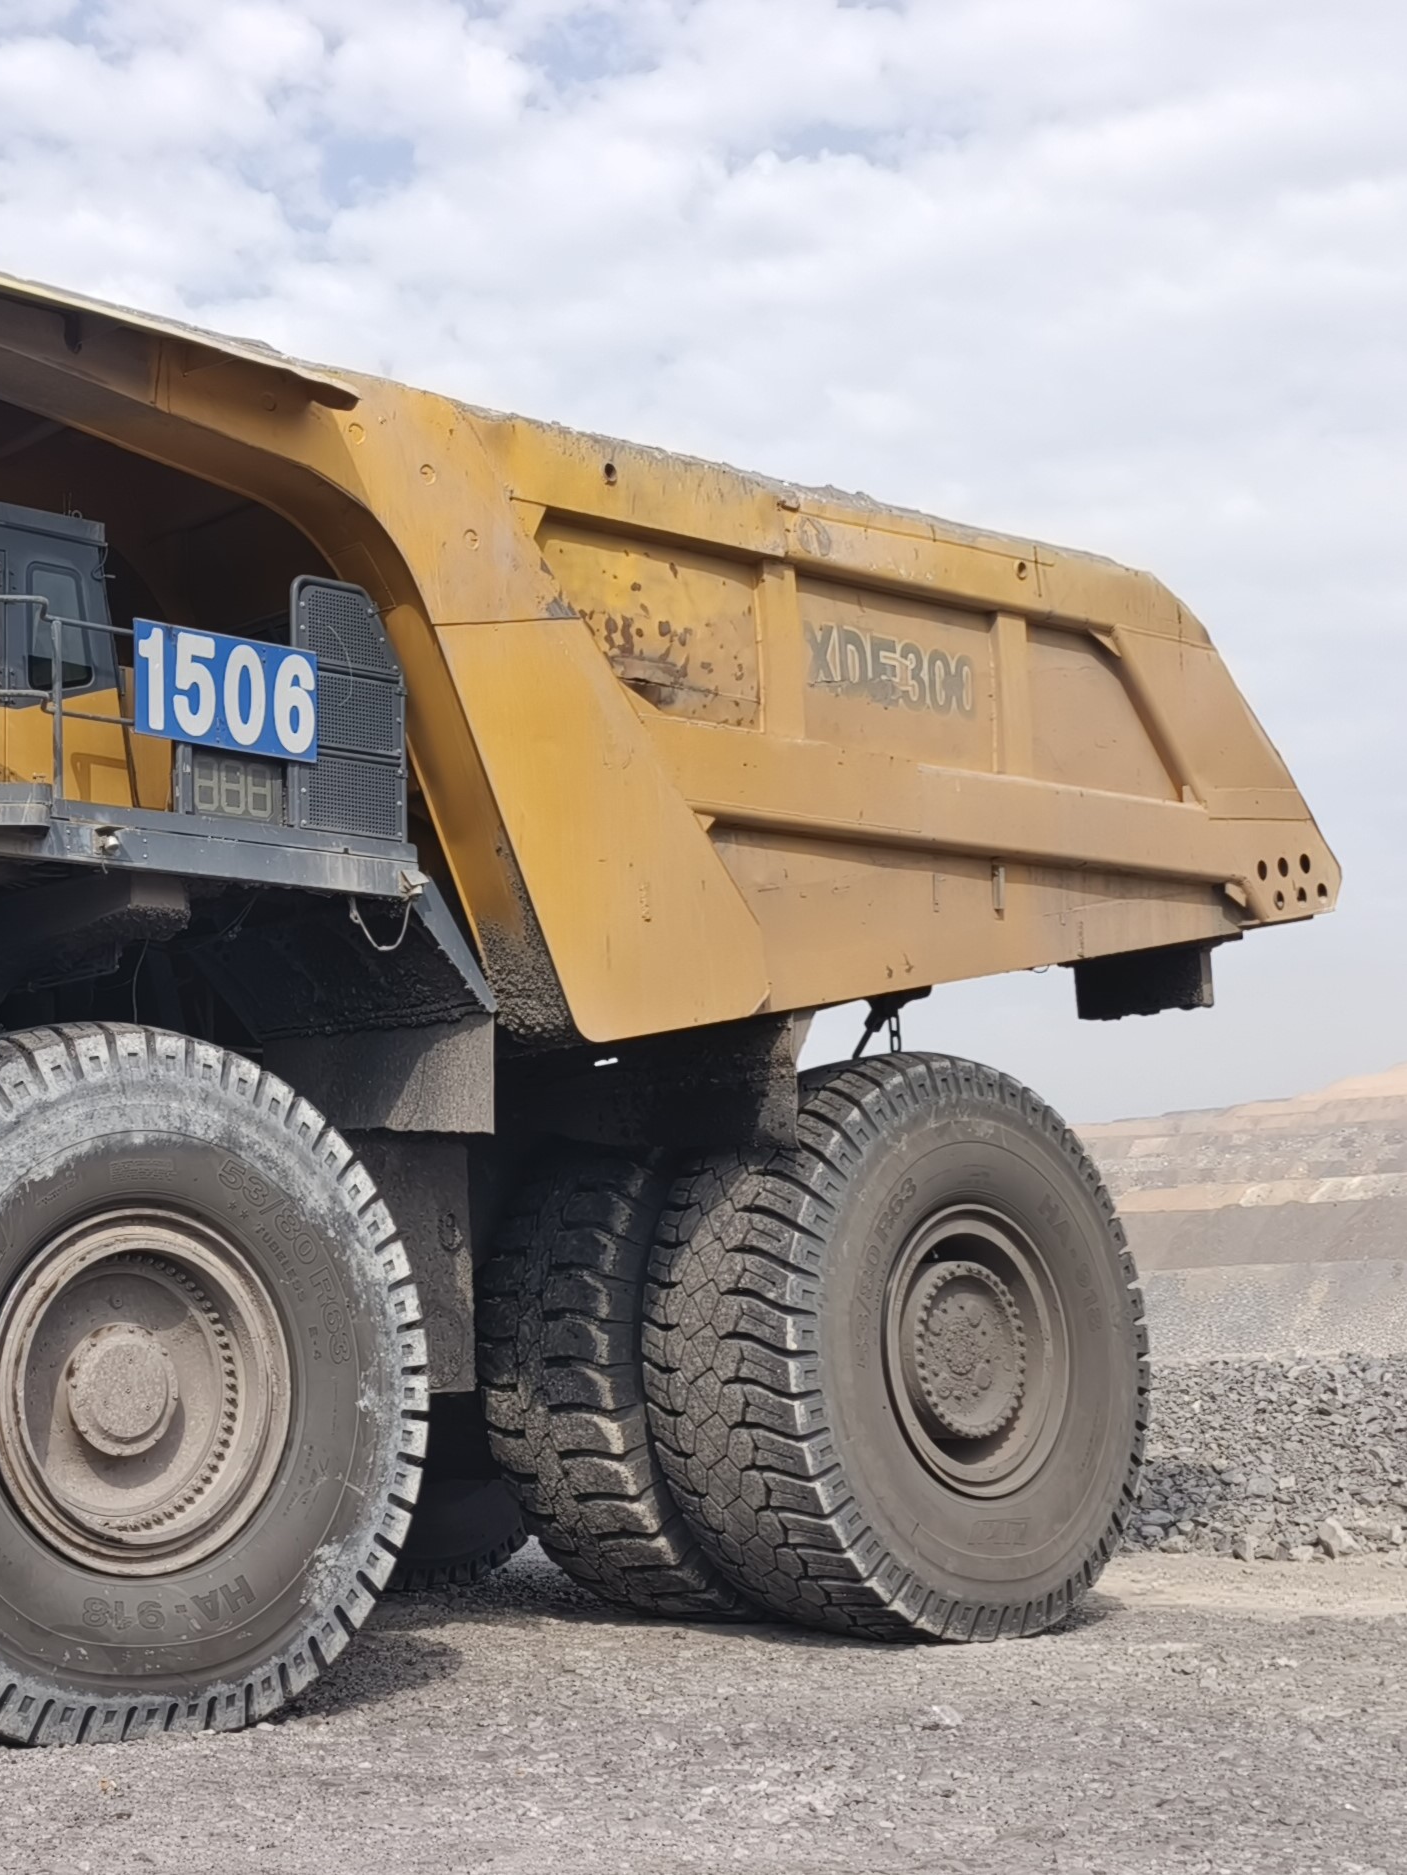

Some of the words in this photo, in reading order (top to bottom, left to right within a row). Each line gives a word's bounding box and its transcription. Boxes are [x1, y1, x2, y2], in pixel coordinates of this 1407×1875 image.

[139, 627, 315, 754] 1506
[873, 1177, 917, 1245] R63
[218, 1159, 318, 1265] 53/80
[309, 1264, 352, 1365] R63
[254, 1223, 307, 1303] TUBELESS
[82, 1574, 256, 1631] HA-918
